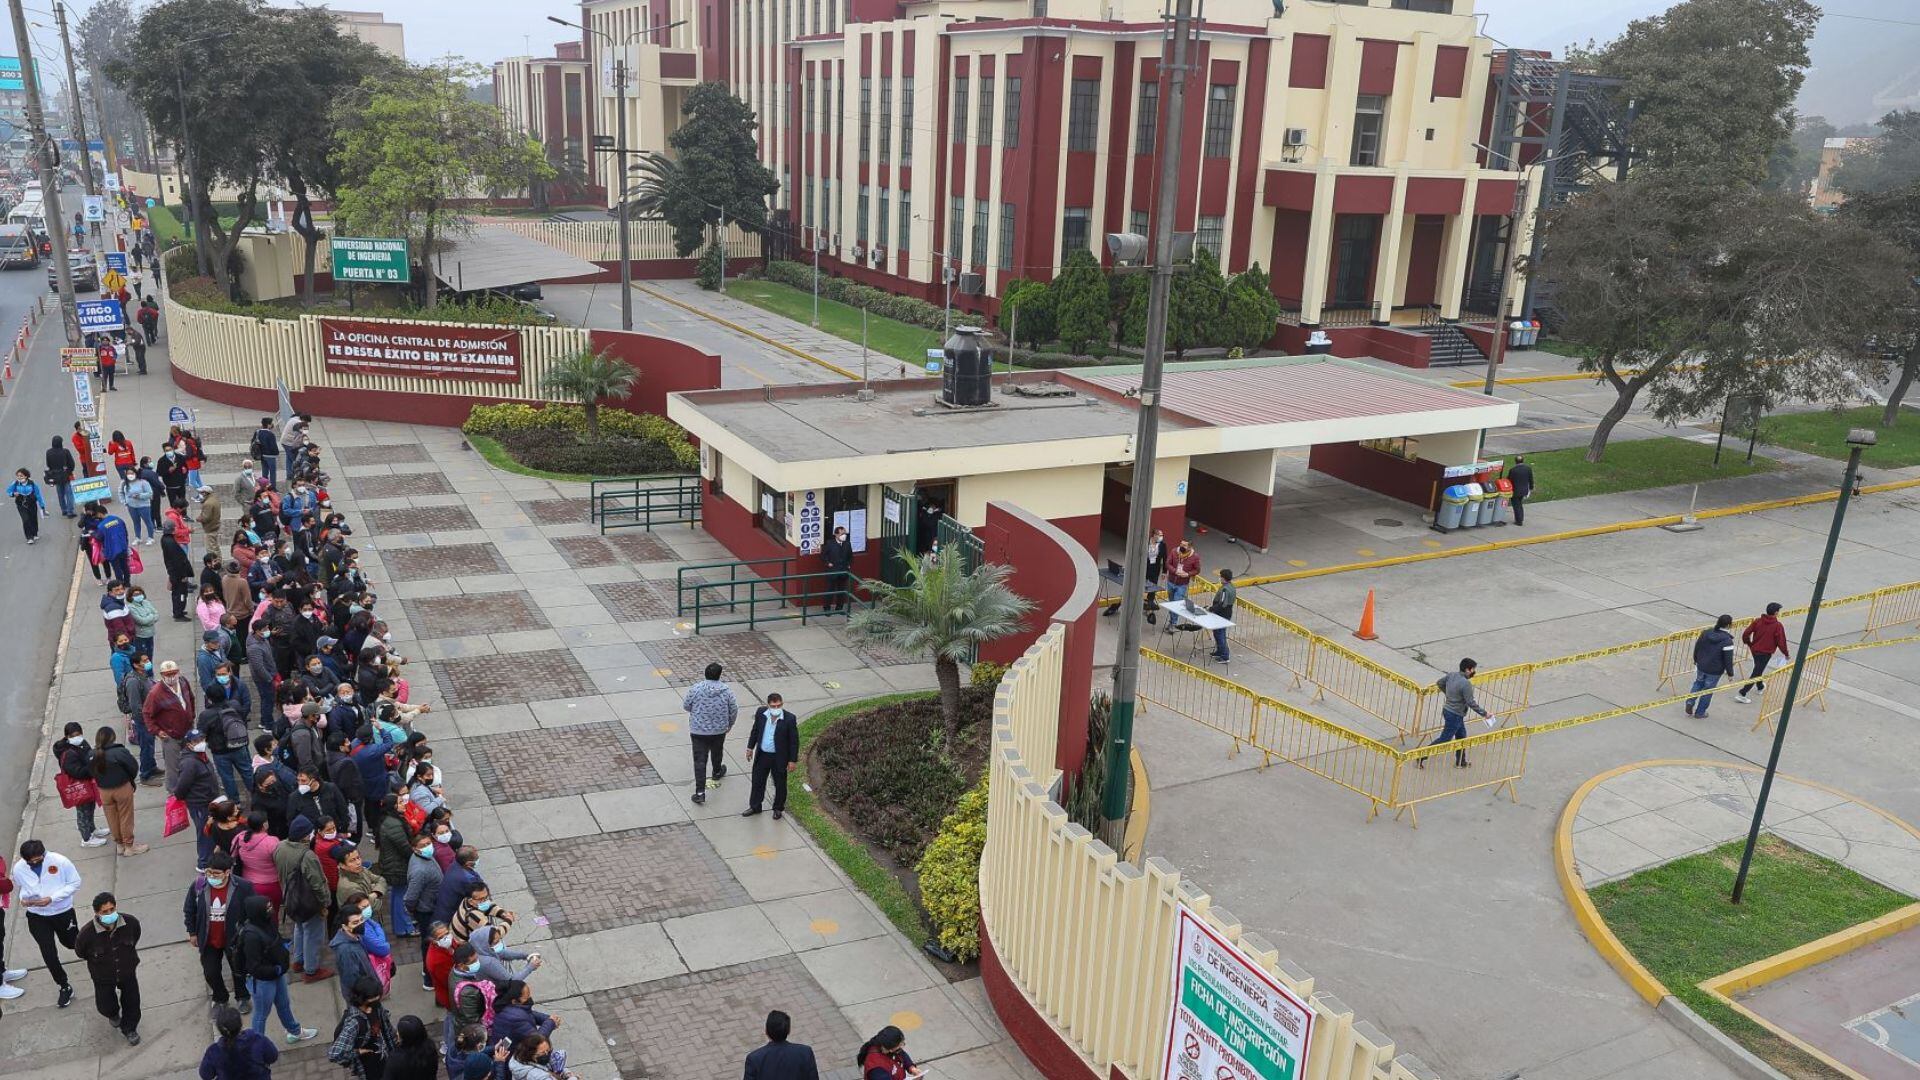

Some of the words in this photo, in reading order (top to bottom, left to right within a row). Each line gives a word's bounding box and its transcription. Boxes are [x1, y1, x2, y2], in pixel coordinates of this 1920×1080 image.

[333, 240, 373, 250] UNIVERSIDAD
[374, 241, 404, 251] NACIONAL
[347, 251, 356, 260] DE
[342, 267, 374, 278] PUERTA
[387, 269, 398, 279] 03
[333, 332, 346, 341] LA
[348, 333, 390, 344] OFICINA
[391, 336, 436, 347] CENTRAL
[438, 339, 451, 348] DE
[453, 339, 507, 350] ADMISIÓN
[328, 345, 342, 355] TE
[344, 345, 382, 358] DESEA
[384, 346, 420, 360] ÉXITO
[423, 350, 440, 362] EN
[442, 352, 458, 362] TU
[460, 353, 514, 365] EXAMEN
[76, 403, 94, 412] TESIS
[1207, 952, 1219, 970] DE
[1219, 962, 1268, 1012] INGENIERÍA
[1180, 1008, 1219, 1053] TOTALMENTE
[1191, 976, 1214, 1010] FICHA
[1215, 999, 1228, 1021] DE
[1228, 1009, 1287, 1072] INSCRIPCIÓN
[1223, 1022, 1230, 1039] Y
[1229, 1029, 1246, 1055] DNI
